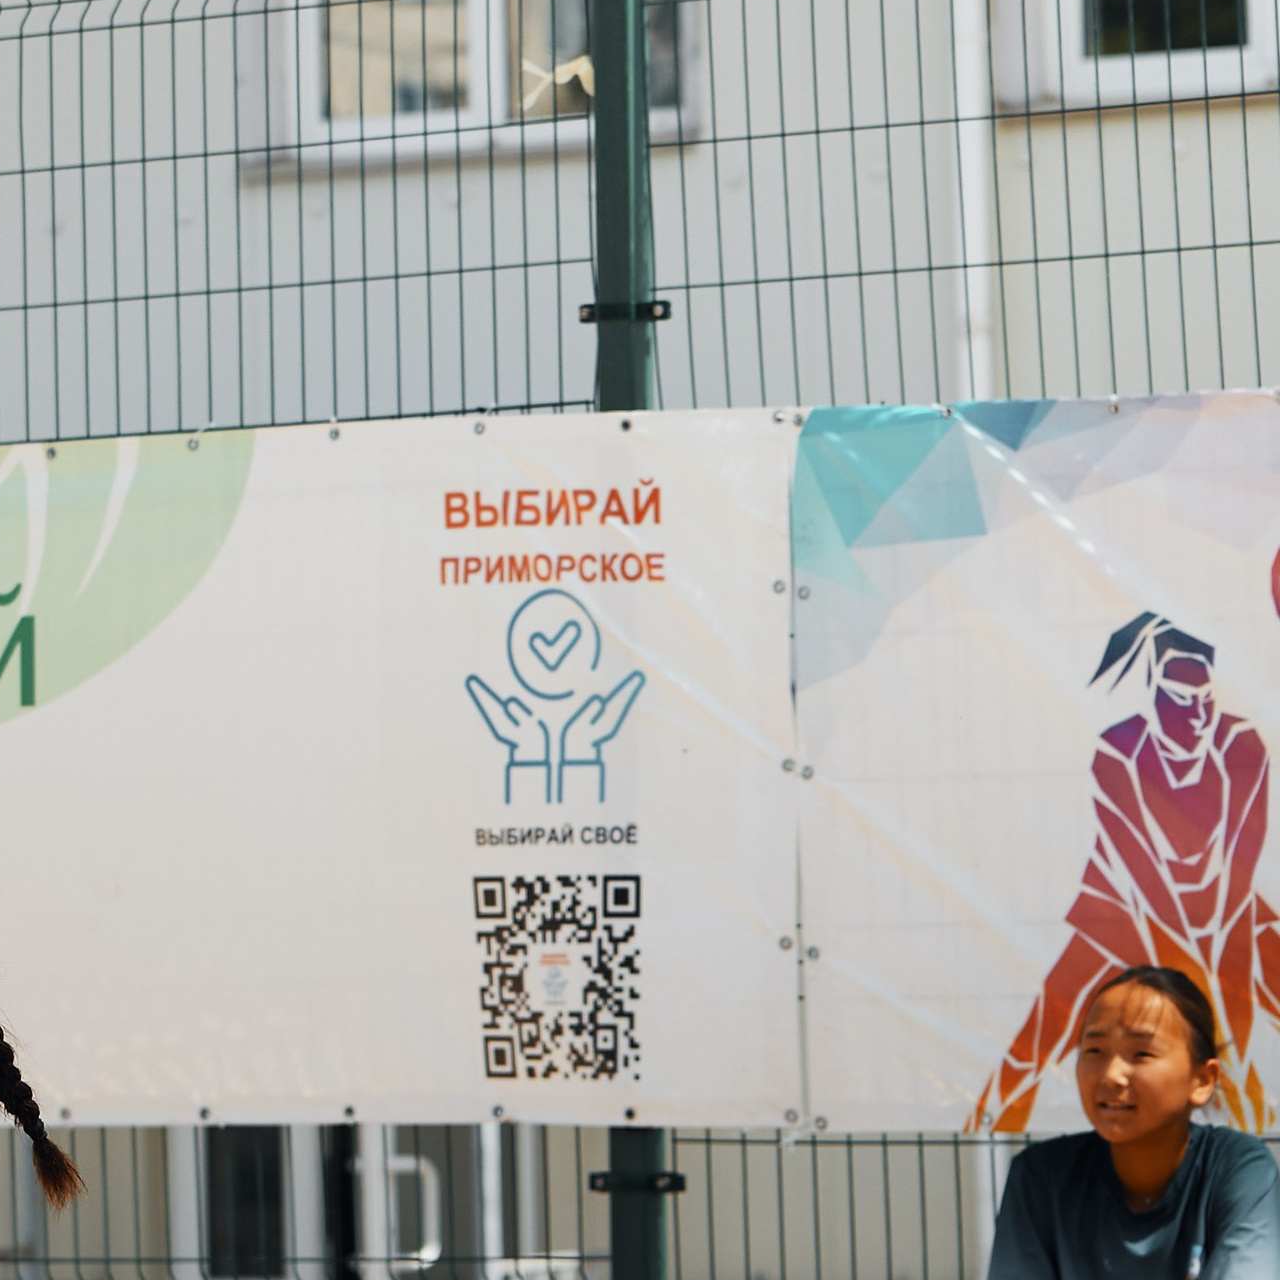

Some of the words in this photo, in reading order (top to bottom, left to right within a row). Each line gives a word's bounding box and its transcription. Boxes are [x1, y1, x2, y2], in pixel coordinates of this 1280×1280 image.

[444, 478, 662, 529] ВЫБИРАЙ
[440, 552, 665, 585] ПРИМОРСКОЕ
[475, 825, 574, 846] ВЫБИРАЙ
[580, 822, 638, 846] СВОЁ
